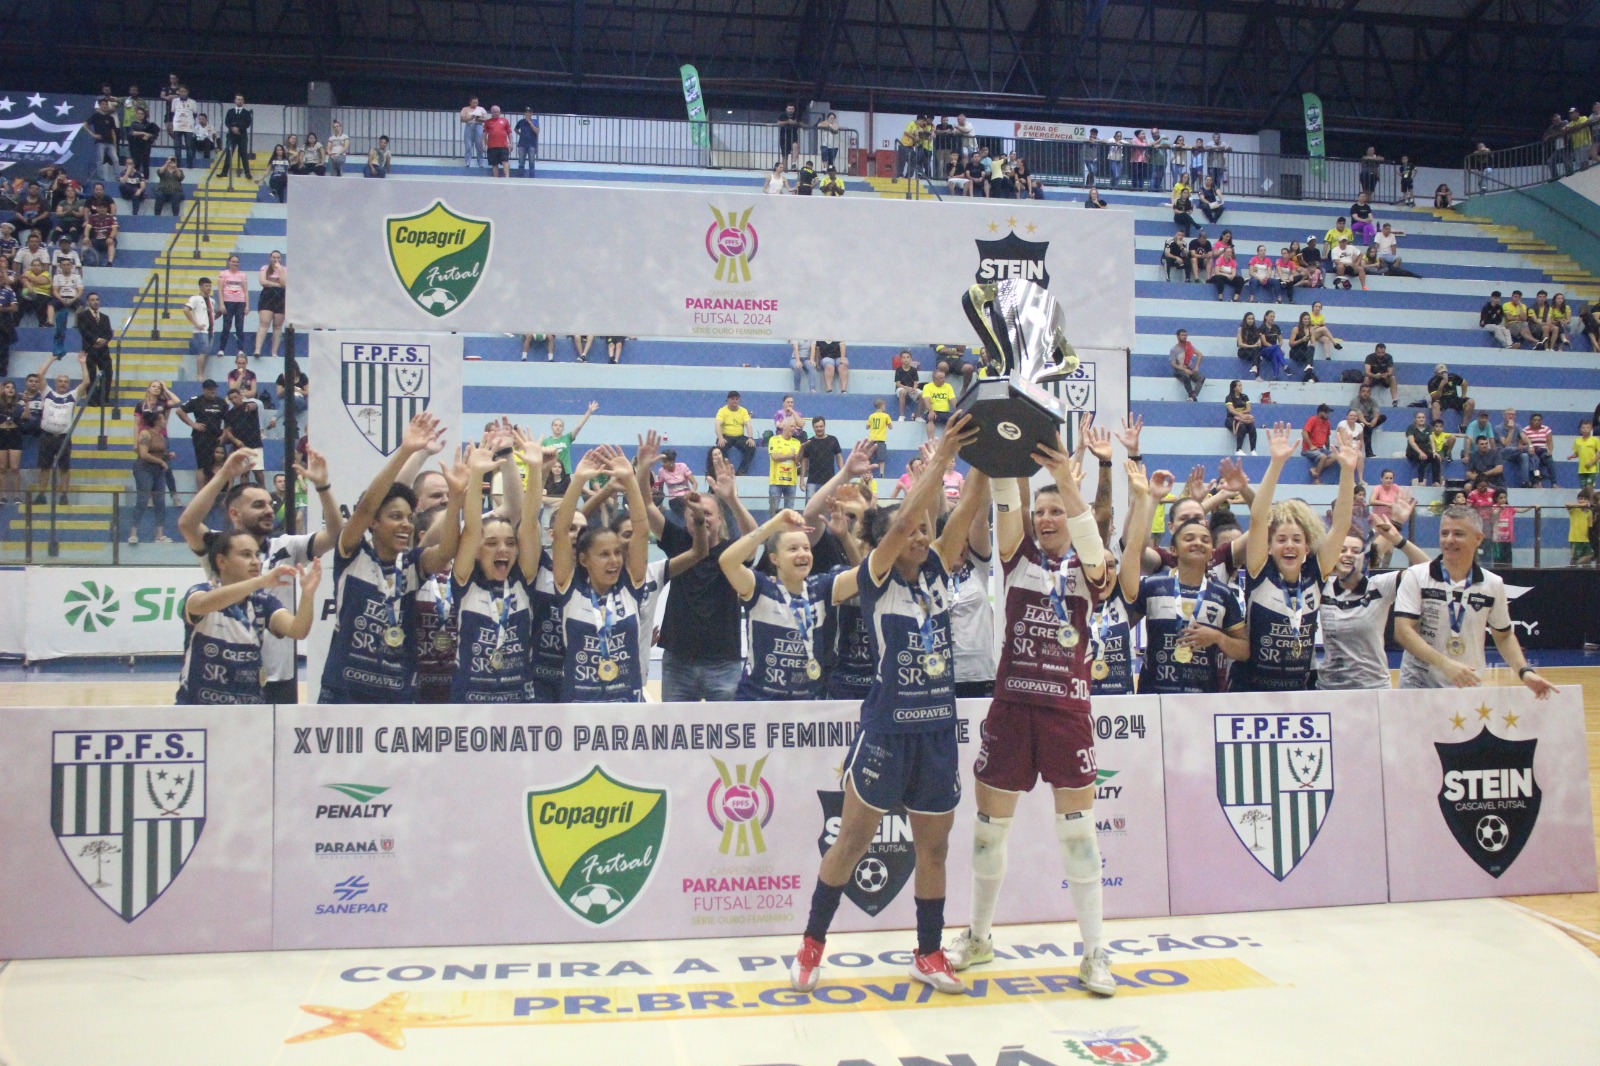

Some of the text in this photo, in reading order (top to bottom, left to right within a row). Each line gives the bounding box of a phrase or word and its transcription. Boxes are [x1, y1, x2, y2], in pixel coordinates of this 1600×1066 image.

[1023, 123, 1046, 132] SAÍDA
[1023, 131, 1074, 140] EMERGÊNCIA
[1074, 127, 1085, 136] 02
[0, 138, 72, 155] TEIN
[395, 226, 466, 248] Copagril
[426, 261, 480, 287] Futsal
[980, 258, 1044, 280] STEIN
[685, 297, 778, 311] PARANAENSE
[694, 312, 772, 325] FUTSAL 2024
[354, 345, 423, 363] F.P.F.S.
[1007, 679, 1065, 695] COOPAVEL
[1070, 678, 1088, 701] 30
[897, 707, 950, 720] COOPAVEL
[293, 715, 1146, 754] XVIII CAMPEONATO PARANAENSE FEMINI 024
[1231, 716, 1322, 739] F.P.F.S.
[75, 733, 193, 760] F.P.F.S.
[1443, 768, 1533, 802] STEIN
[315, 804, 393, 819] PENALTY
[1455, 800, 1527, 812] CASCAVEL FUTSAL
[539, 801, 634, 829] Copagril
[824, 814, 915, 845] SEIN
[315, 840, 378, 853] PARANÁ
[879, 844, 908, 853] FUTSAL
[581, 845, 653, 883] Futsal
[682, 875, 801, 893] PARANAENSE
[315, 903, 389, 915] SANEPAR
[694, 894, 793, 911] FUTSAL 2024
[340, 960, 653, 983] CONFIRA
[673, 958, 720, 975] A
